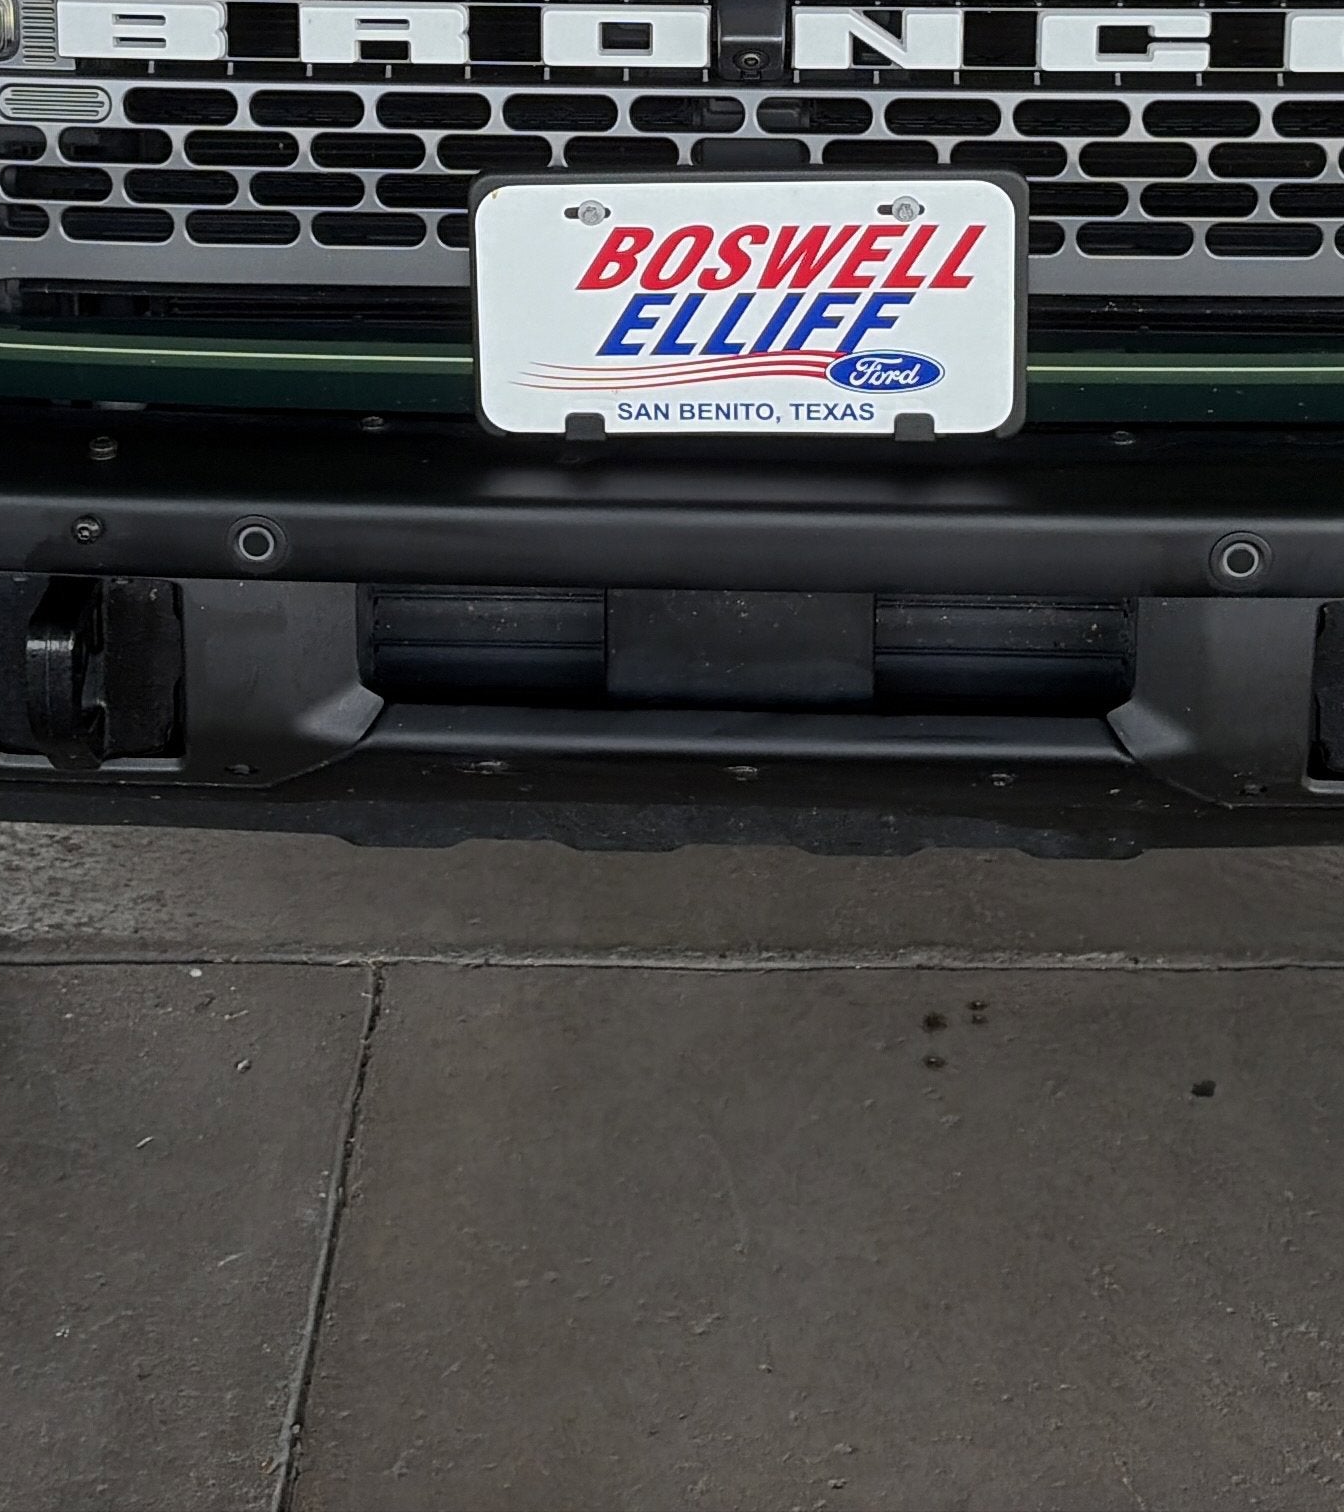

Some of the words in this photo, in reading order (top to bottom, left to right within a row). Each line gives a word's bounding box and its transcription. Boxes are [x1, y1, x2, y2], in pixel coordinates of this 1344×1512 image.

[574, 224, 988, 291] BOSWELL
[595, 291, 917, 357] ELLIFF
[848, 356, 922, 387] Ford
[617, 402, 671, 422] SAN
[678, 402, 782, 425] BENITO,
[789, 402, 876, 422] TEXAS
